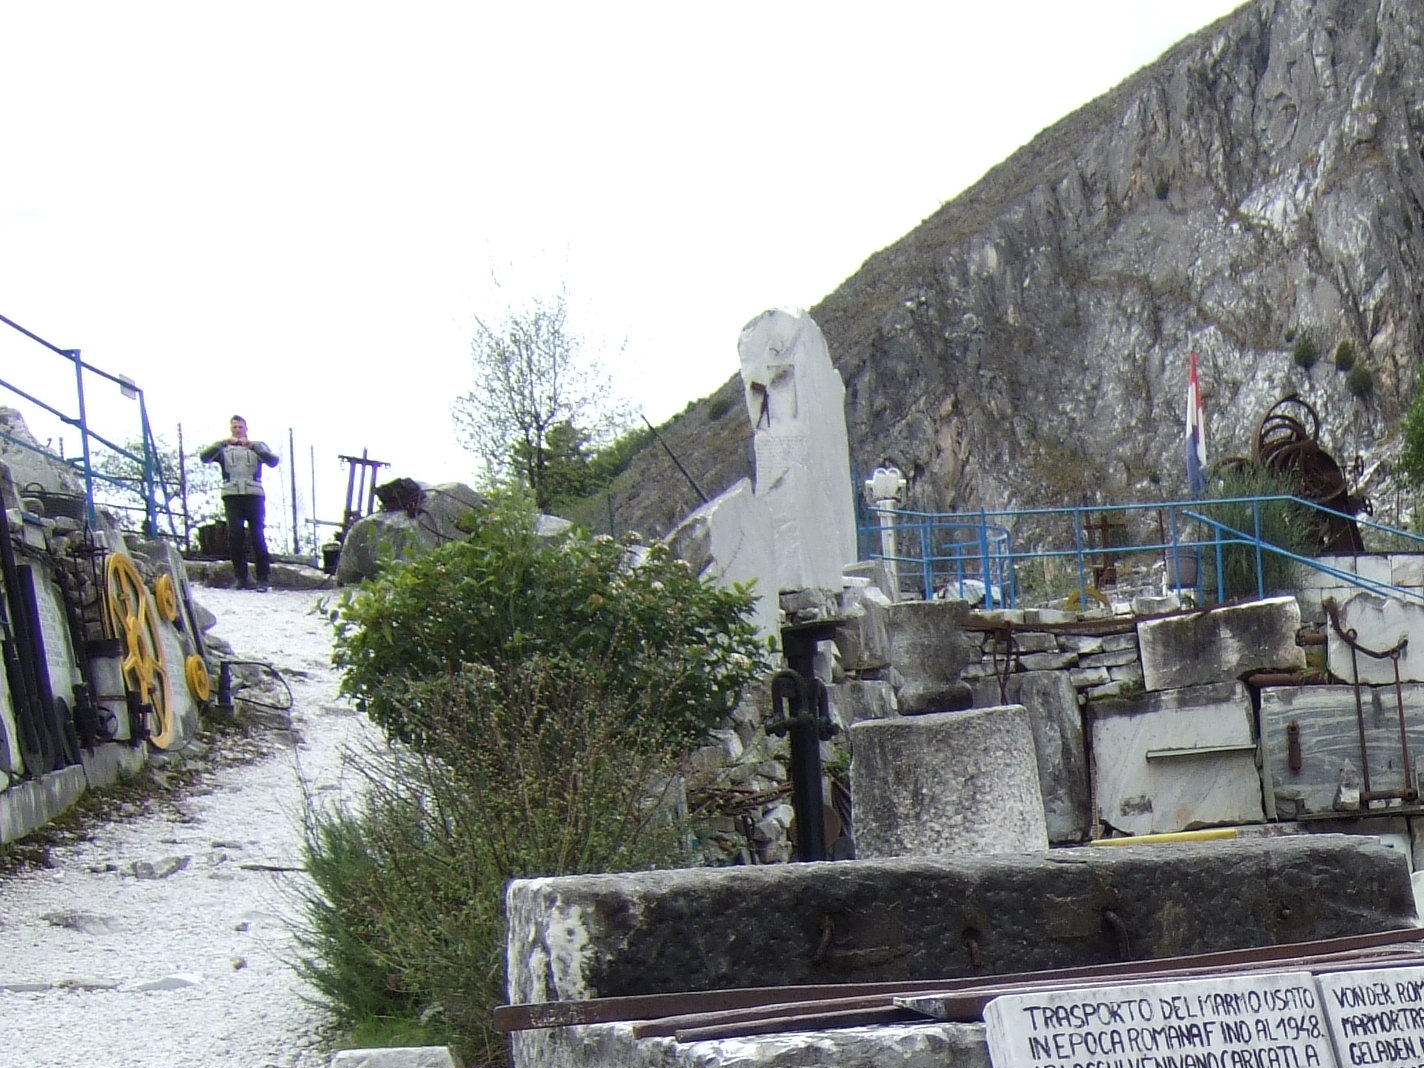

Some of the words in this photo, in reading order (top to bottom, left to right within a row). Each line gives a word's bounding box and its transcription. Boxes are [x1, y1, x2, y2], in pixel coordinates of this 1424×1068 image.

[1023, 999, 1154, 1030] TRASPORTO
[1159, 996, 1198, 1020] DEL
[1198, 991, 1260, 1017] MARMO
[1264, 986, 1315, 1011] USATO
[1332, 986, 1366, 1008] VON
[1028, 1035, 1052, 1060] IN
[1053, 1029, 1125, 1059] EPOCA
[1127, 1023, 1204, 1052] ROMANA
[1255, 1018, 1278, 1041] AL
[1276, 1015, 1325, 1040] 1948.
[1306, 1044, 1320, 1067] A
